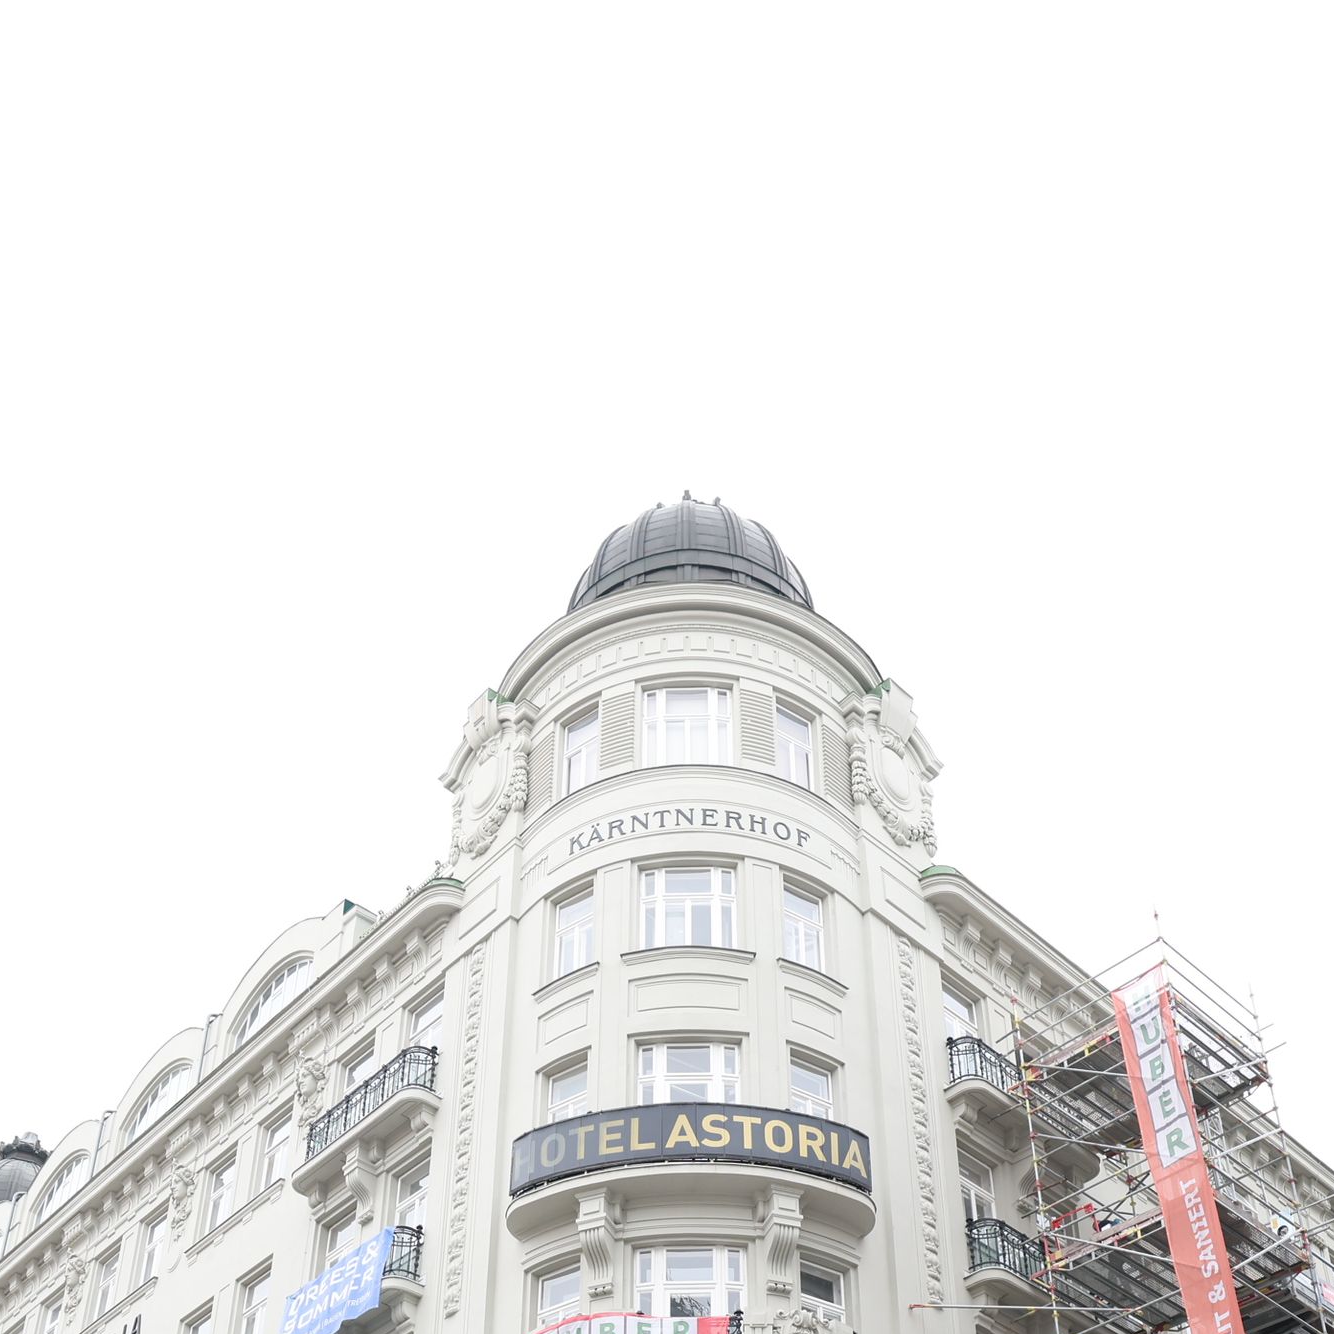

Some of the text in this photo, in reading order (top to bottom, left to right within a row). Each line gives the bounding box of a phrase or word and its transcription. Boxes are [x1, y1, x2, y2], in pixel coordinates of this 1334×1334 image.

[568, 808, 811, 856] KÄRNTNERHOF
[514, 1114, 868, 1180] HOTEL ASTORIA
[1179, 1178, 1219, 1278] SANIERT
[289, 1256, 359, 1316] DREES
[1208, 1280, 1225, 1304] &
